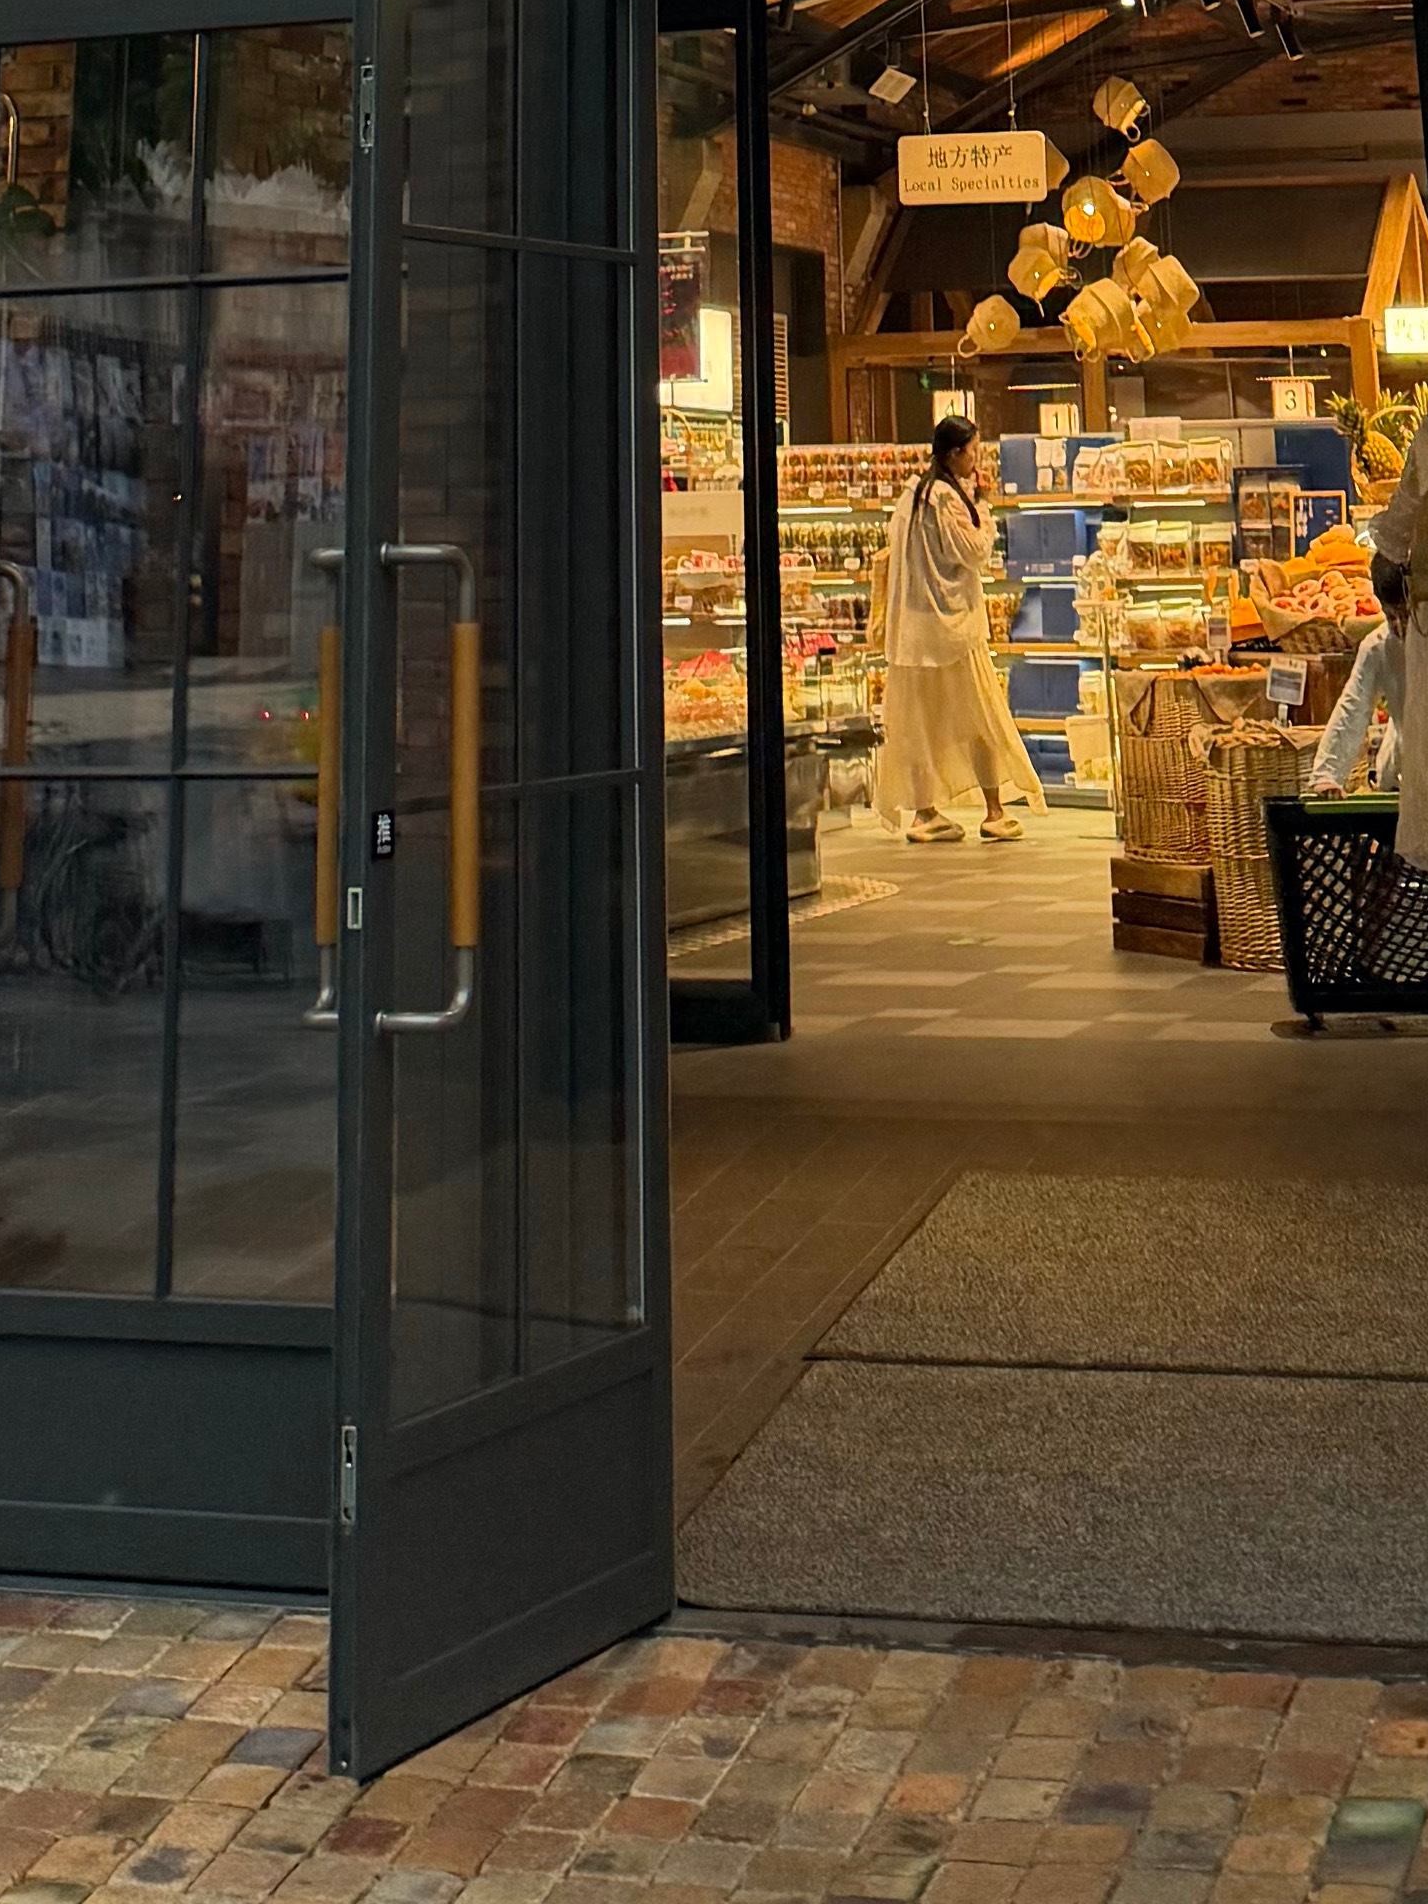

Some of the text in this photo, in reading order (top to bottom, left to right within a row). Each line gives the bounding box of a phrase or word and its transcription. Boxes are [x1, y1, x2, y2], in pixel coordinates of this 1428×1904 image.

[927, 143, 1013, 169] 地方特产
[903, 174, 1040, 194] Local Specialties
[1284, 388, 1297, 411] 3
[1052, 411, 1059, 431] 1
